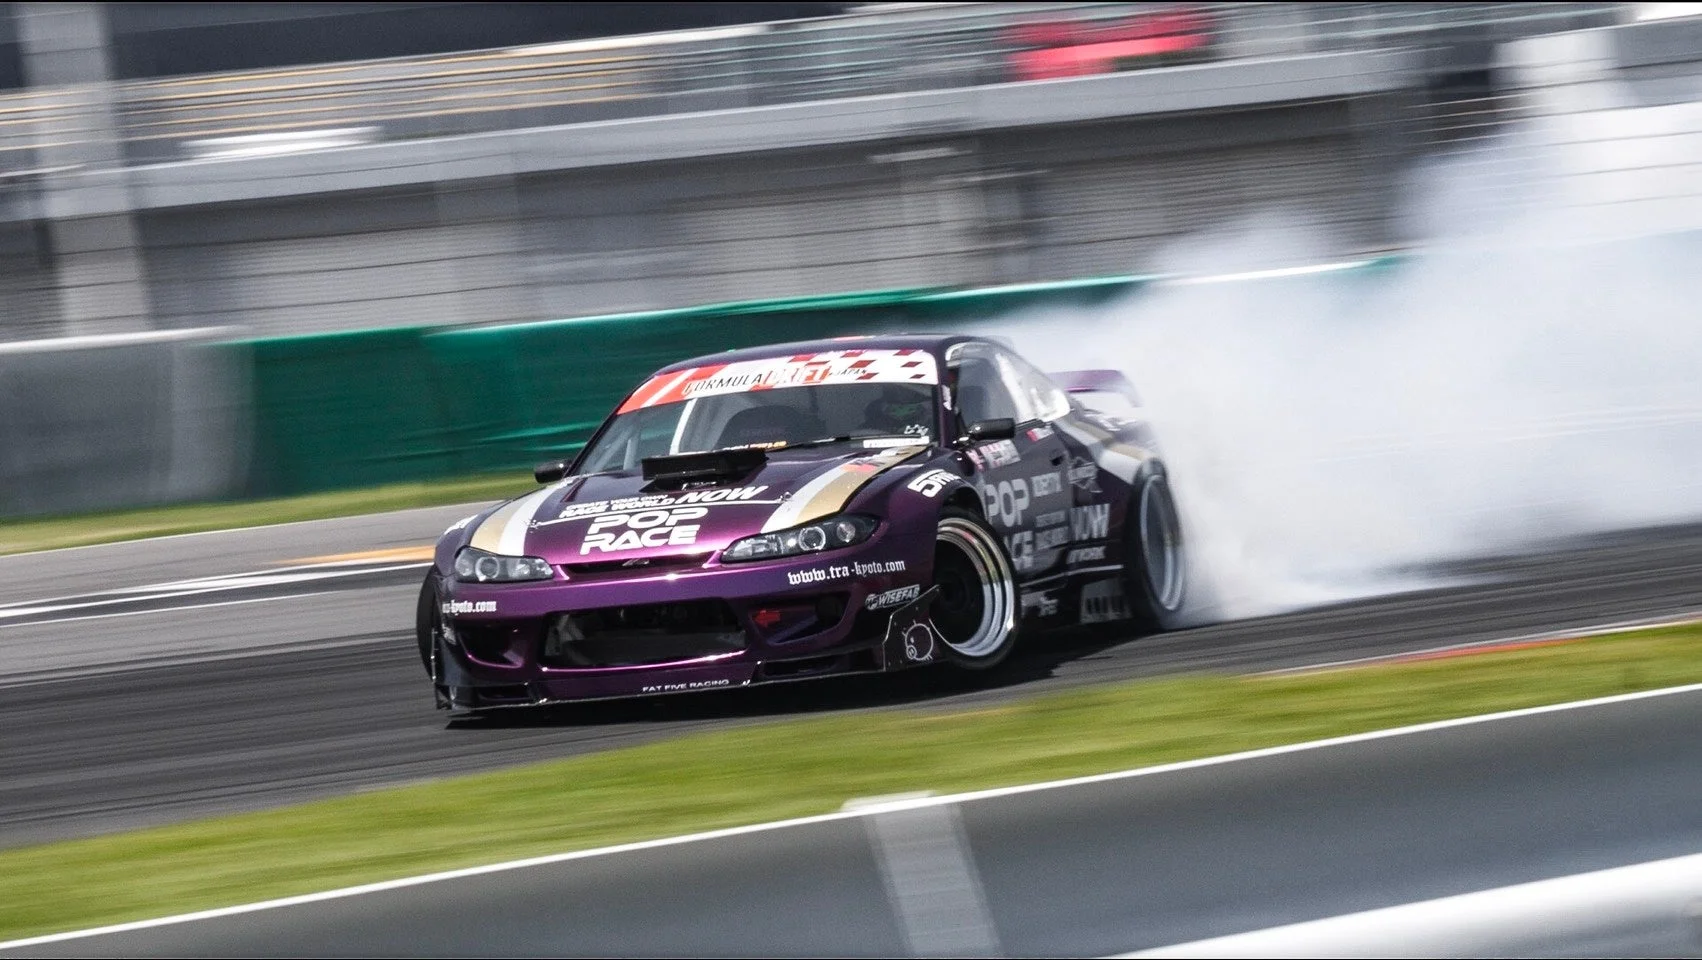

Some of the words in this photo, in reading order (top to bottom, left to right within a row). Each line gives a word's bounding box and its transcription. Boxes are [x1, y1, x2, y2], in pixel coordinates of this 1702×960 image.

[684, 372, 763, 395] FORMULA
[558, 503, 610, 519] RACE
[611, 496, 677, 511] WORLD
[674, 485, 769, 505] NOW
[585, 506, 709, 536] POP
[579, 524, 701, 556] RACE
[877, 585, 921, 606] WISEFAB
[642, 685, 662, 693] FAT
[664, 683, 687, 691] FIVE
[689, 679, 730, 689] RACING
